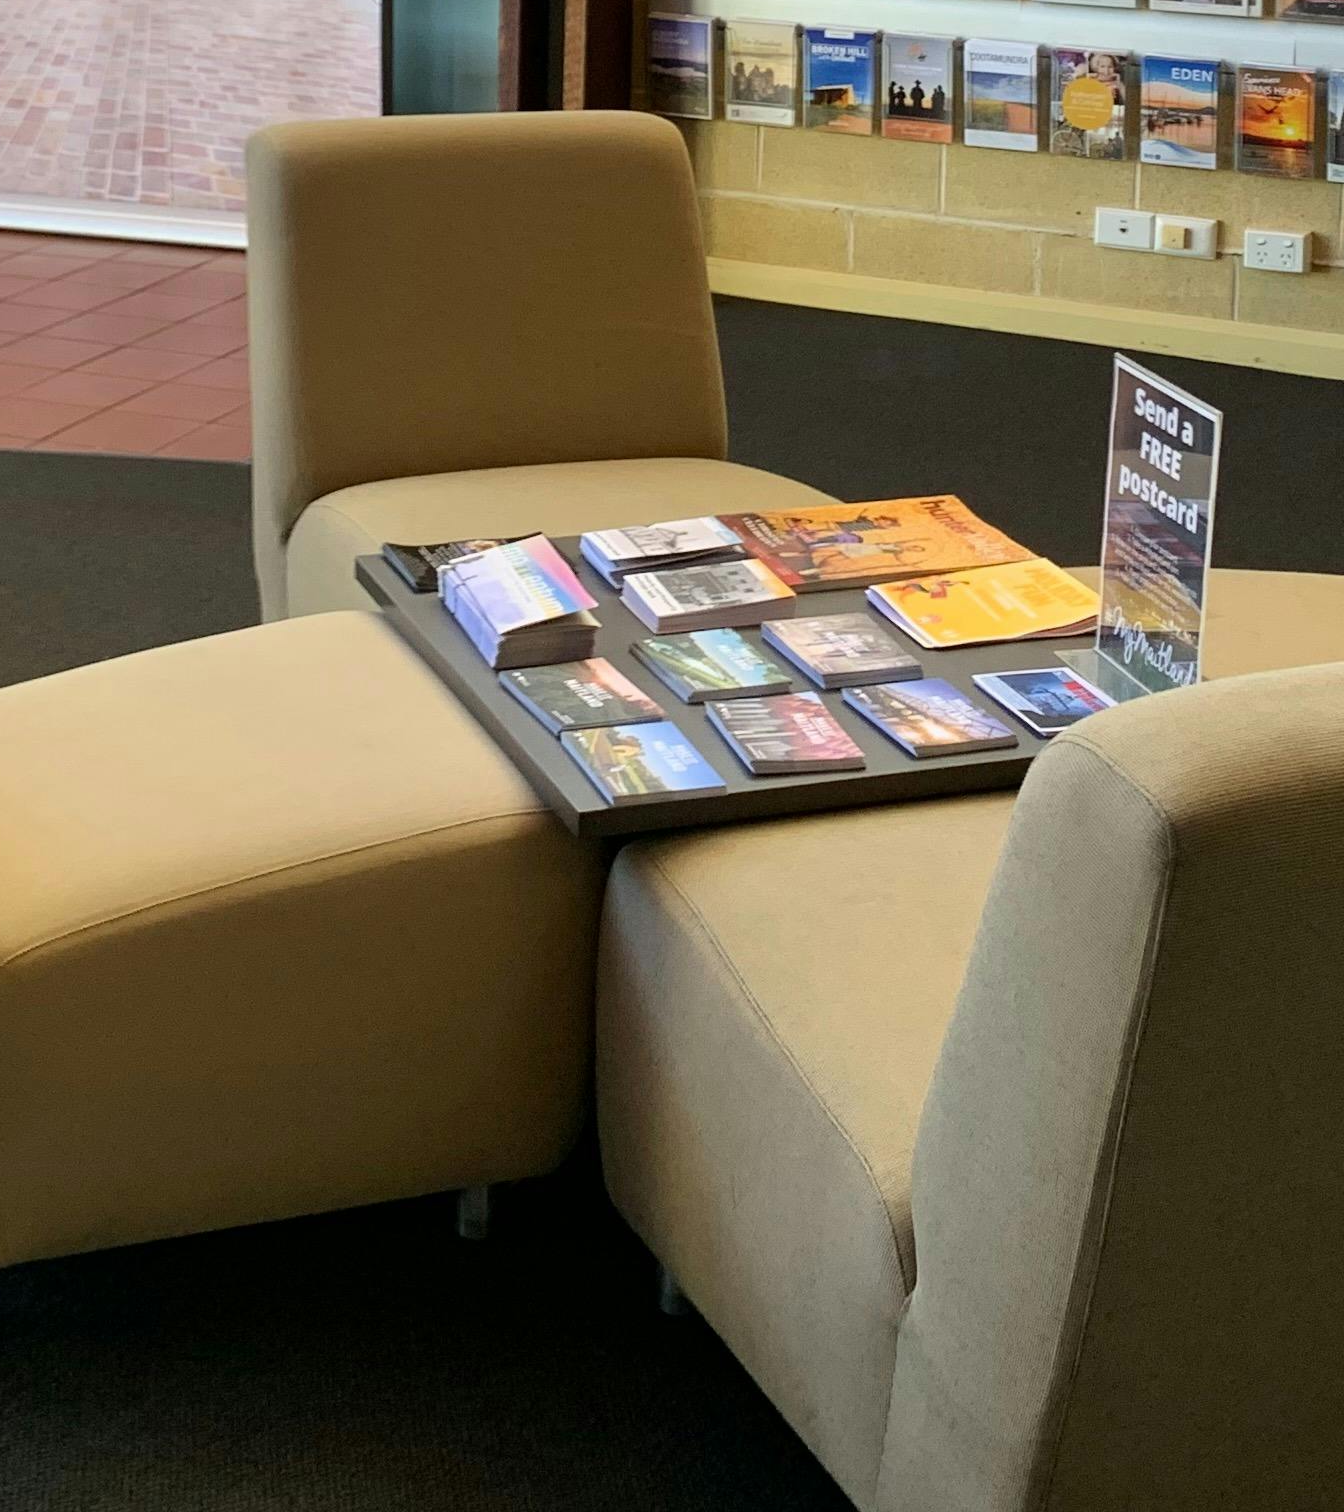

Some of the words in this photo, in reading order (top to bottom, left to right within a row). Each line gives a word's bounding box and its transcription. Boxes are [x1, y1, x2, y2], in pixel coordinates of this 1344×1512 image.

[811, 44, 846, 56] BROKEN
[846, 46, 869, 58] HILL
[1171, 66, 1214, 83] EDEN
[1134, 387, 1179, 437] Send
[1181, 420, 1194, 447] a
[1140, 431, 1183, 482] FREE
[1118, 463, 1199, 534] postcard
[1104, 605, 1195, 687] #MyMaitland
